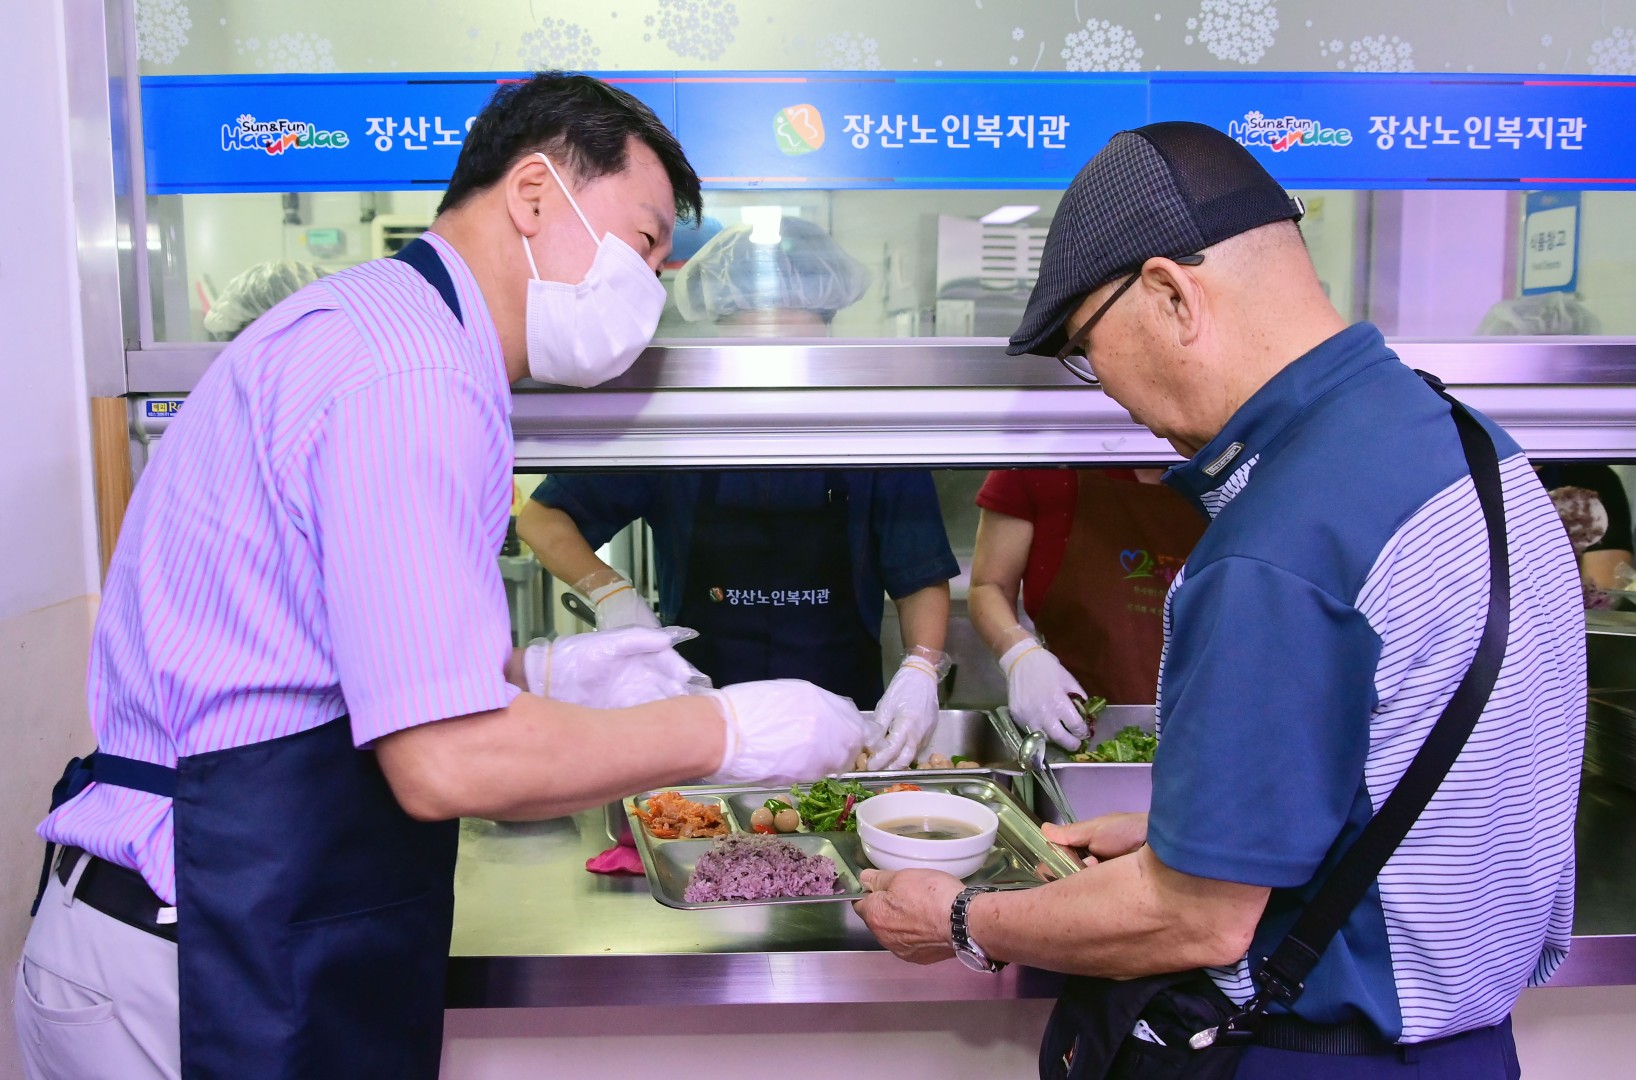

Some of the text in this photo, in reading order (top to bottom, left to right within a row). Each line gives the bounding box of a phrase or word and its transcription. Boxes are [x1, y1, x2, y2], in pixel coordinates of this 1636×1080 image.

[221, 123, 350, 155] Haeundae
[242, 120, 305, 133] Sun&Fun
[365, 116, 477, 152] 장산노
[842, 113, 1070, 149] 장산노인복지관
[1229, 120, 1353, 152] Haeundae
[1249, 117, 1311, 130] Sun&Fun
[1368, 114, 1587, 150] 장산노인복지관
[726, 588, 830, 606] 장산노인복지관
